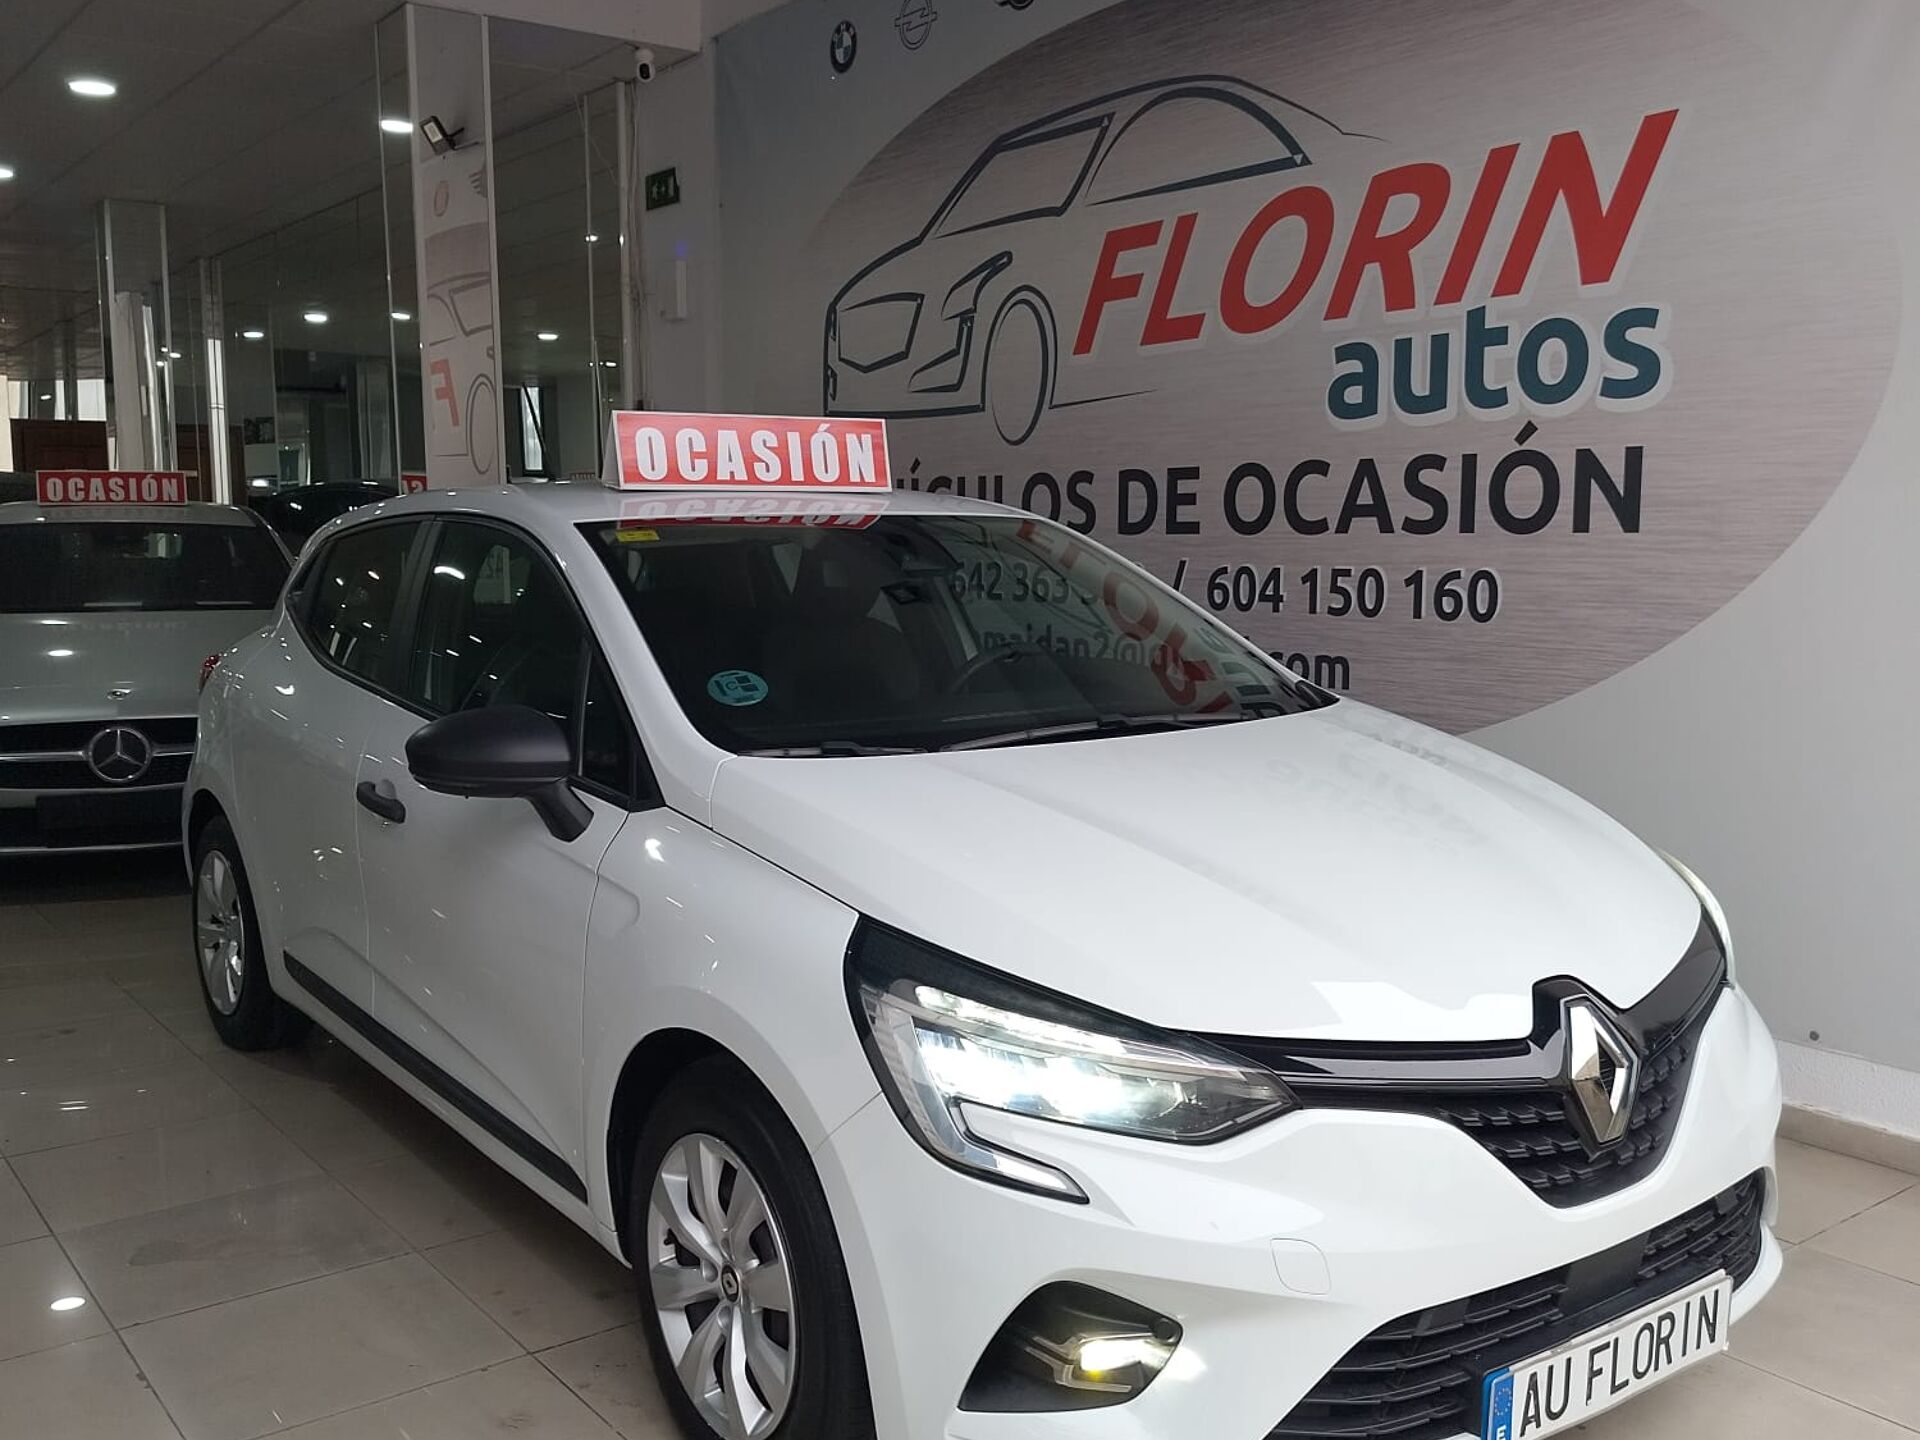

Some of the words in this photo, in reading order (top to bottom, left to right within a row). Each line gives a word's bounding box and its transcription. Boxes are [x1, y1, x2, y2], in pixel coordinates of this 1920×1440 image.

[1073, 110, 1679, 355] FLORIN
[1328, 306, 1661, 419] autos
[46, 473, 179, 502] OCASIÓN
[635, 423, 876, 483] OCASIÓN
[1118, 465, 1201, 535] DE
[1224, 420, 1644, 536] OCASIÓN
[1206, 565, 1285, 614] 604
[1300, 567, 1386, 619] 150
[1403, 569, 1500, 624] 160
[1519, 1356, 1572, 1438] AU
[1585, 1288, 1720, 1407] FLORIN
